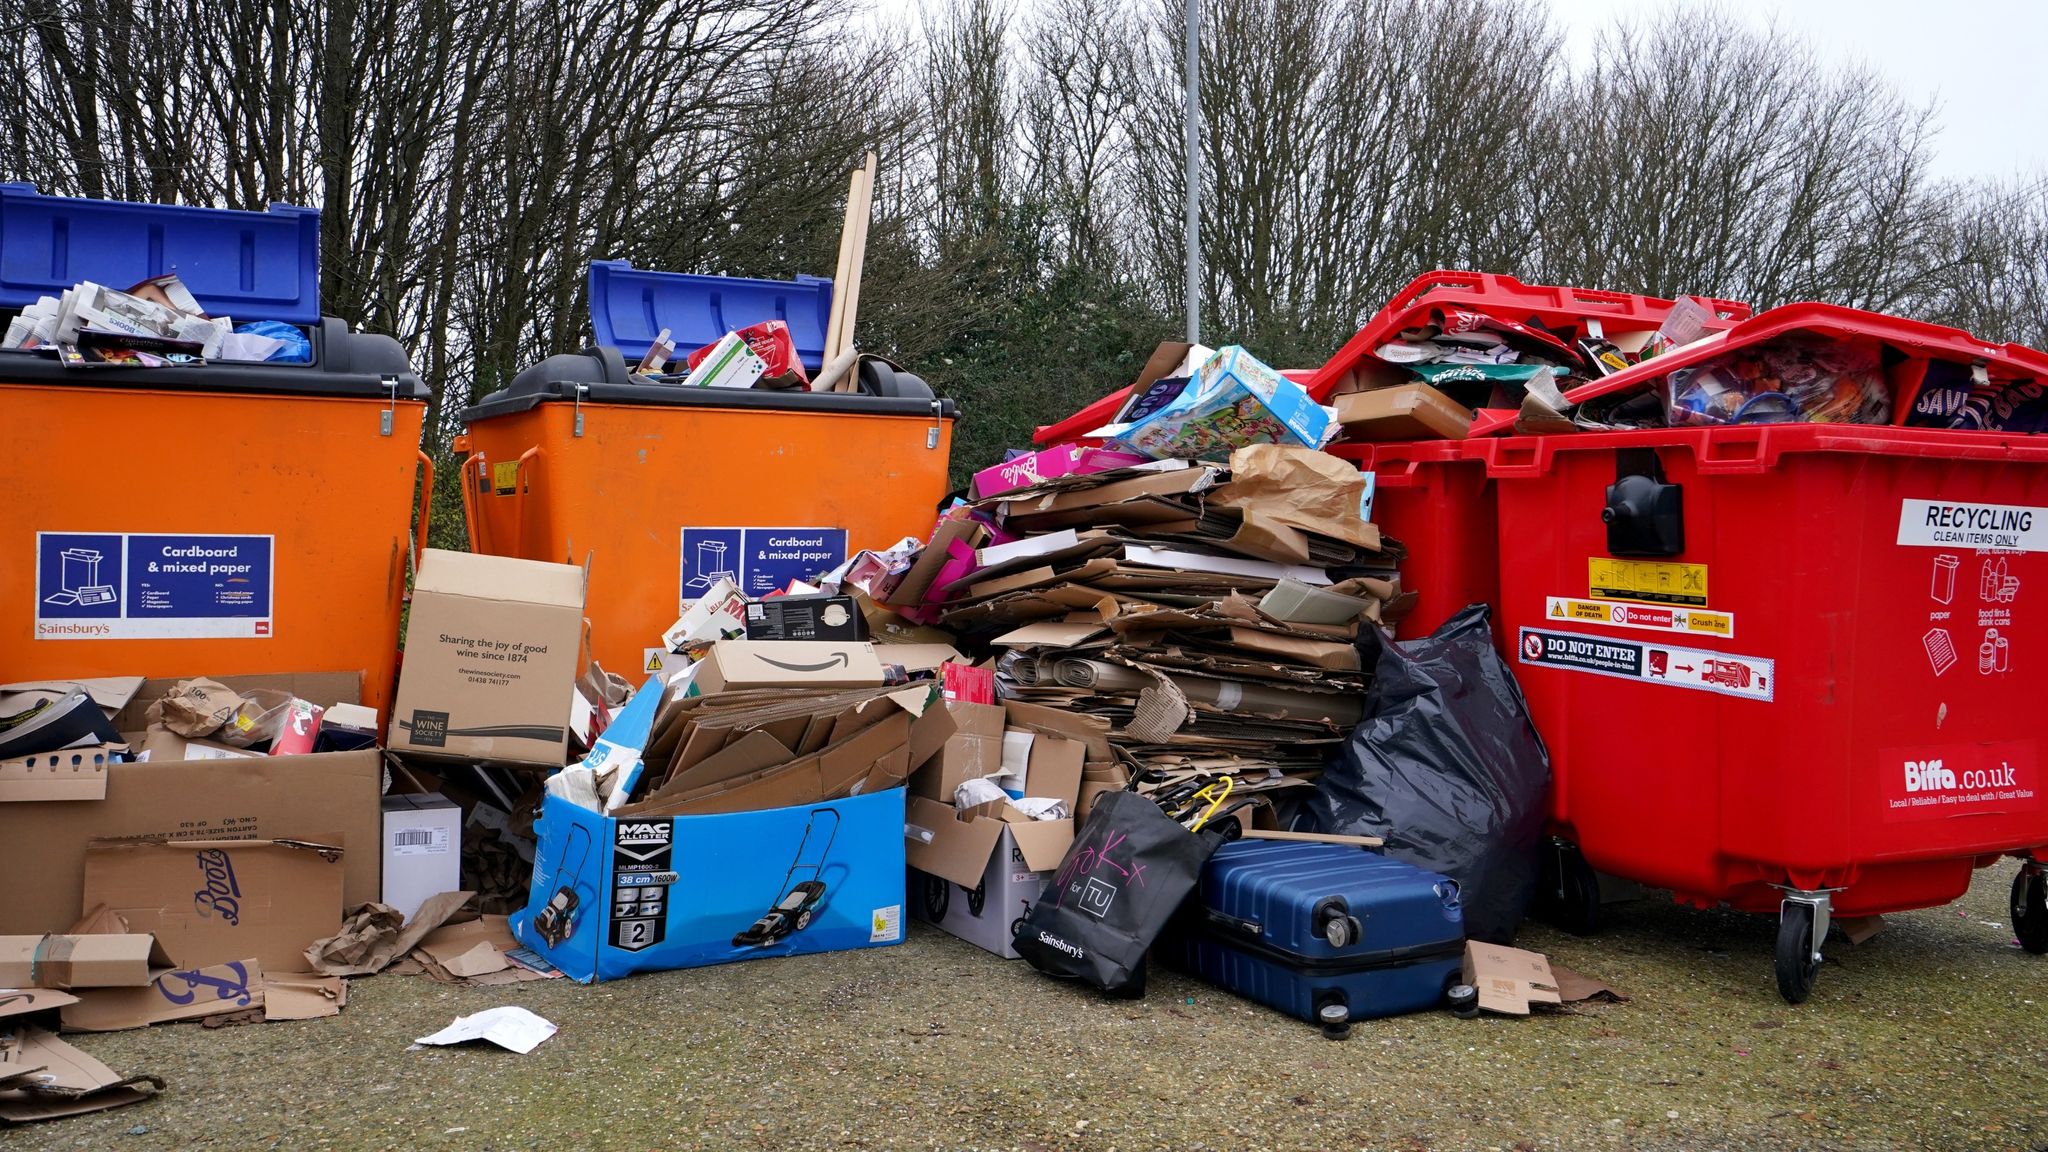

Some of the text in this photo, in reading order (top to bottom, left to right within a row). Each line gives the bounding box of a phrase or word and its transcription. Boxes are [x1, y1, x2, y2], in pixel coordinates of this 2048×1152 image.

[109, 318, 136, 333] BOOKS
[1288, 418, 1317, 445] playmobil
[1001, 456, 1037, 486] Barbie
[1926, 505, 2033, 532] RECYCLING
[769, 537, 823, 547] Cardboard
[1933, 531, 2020, 546] CLEAN ITEMS ONLY
[162, 546, 238, 558] Cardboard
[758, 550, 832, 562] & mixed paper
[147, 561, 252, 575] & mixed paper
[1577, 604, 1601, 612] DANGER
[1978, 609, 1993, 618] food
[1628, 612, 1638, 620] Do
[1652, 615, 1672, 623] enter
[1691, 617, 1713, 627] Crush
[1930, 611, 1951, 621] paper
[1978, 617, 2011, 626] drink cans
[38, 623, 110, 636] Sainsbury's
[439, 634, 548, 654] Sharing the joy of good
[1547, 638, 1636, 662] DO NOT ENTER
[456, 650, 528, 663] wine since 1874
[1547, 653, 1635, 671] www.biffa.co.uk/people-in-bins
[458, 667, 521, 680] thewinesociety.com
[468, 676, 510, 686] 01438 741177
[416, 719, 445, 731] WINE
[414, 729, 444, 737] SOCIETY
[1904, 759, 2017, 792] Biffa.co.uk
[1889, 799, 1908, 808] Local
[1911, 796, 1937, 807] Reliable
[1941, 794, 1957, 804] Easy
[1958, 794, 1965, 802] to
[1966, 792, 1980, 801] deal
[1981, 791, 1995, 800] with
[1999, 790, 2016, 800] Great
[2016, 789, 2034, 798] Value
[226, 825, 257, 833] CARTON
[618, 823, 671, 834] MAC
[620, 874, 678, 884] 38 cm 1600W
[194, 848, 242, 926] Boots
[1070, 881, 1110, 907] for TU
[632, 923, 646, 943] 2
[1038, 931, 1084, 959] Sainsbury's
